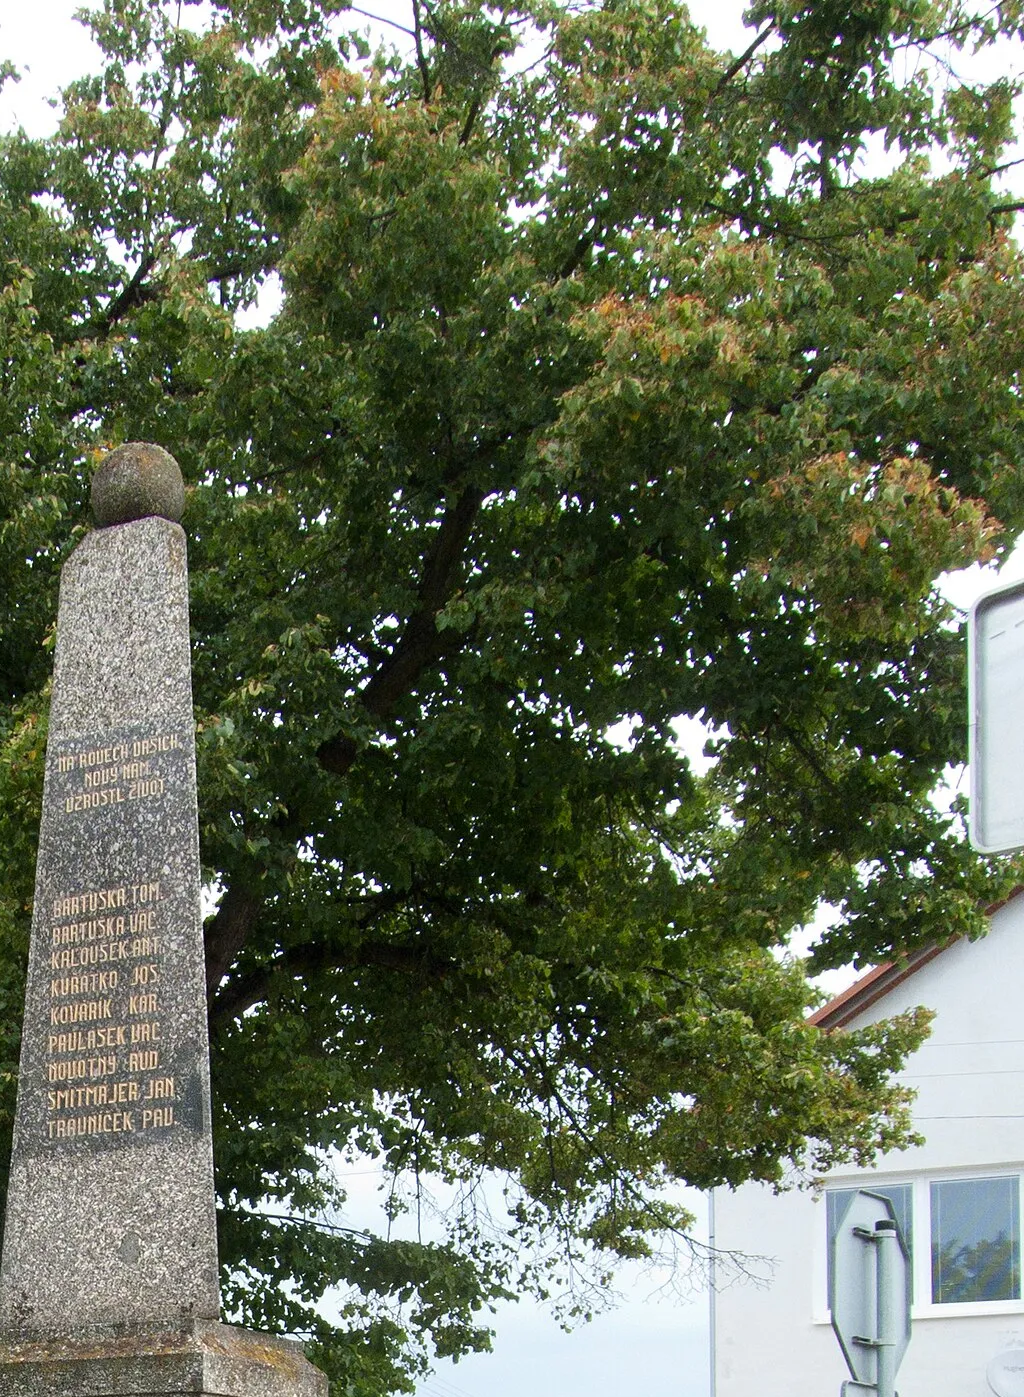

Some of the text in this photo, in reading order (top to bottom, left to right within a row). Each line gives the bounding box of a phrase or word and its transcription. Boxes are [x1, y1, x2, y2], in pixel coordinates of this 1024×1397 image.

[57, 755, 75, 773] NA
[79, 743, 129, 768] ROVECH
[65, 787, 125, 813] VZROSTL
[130, 881, 164, 904] TOM.
[129, 993, 162, 1015] KAR.
[129, 1051, 163, 1072] RUD.
